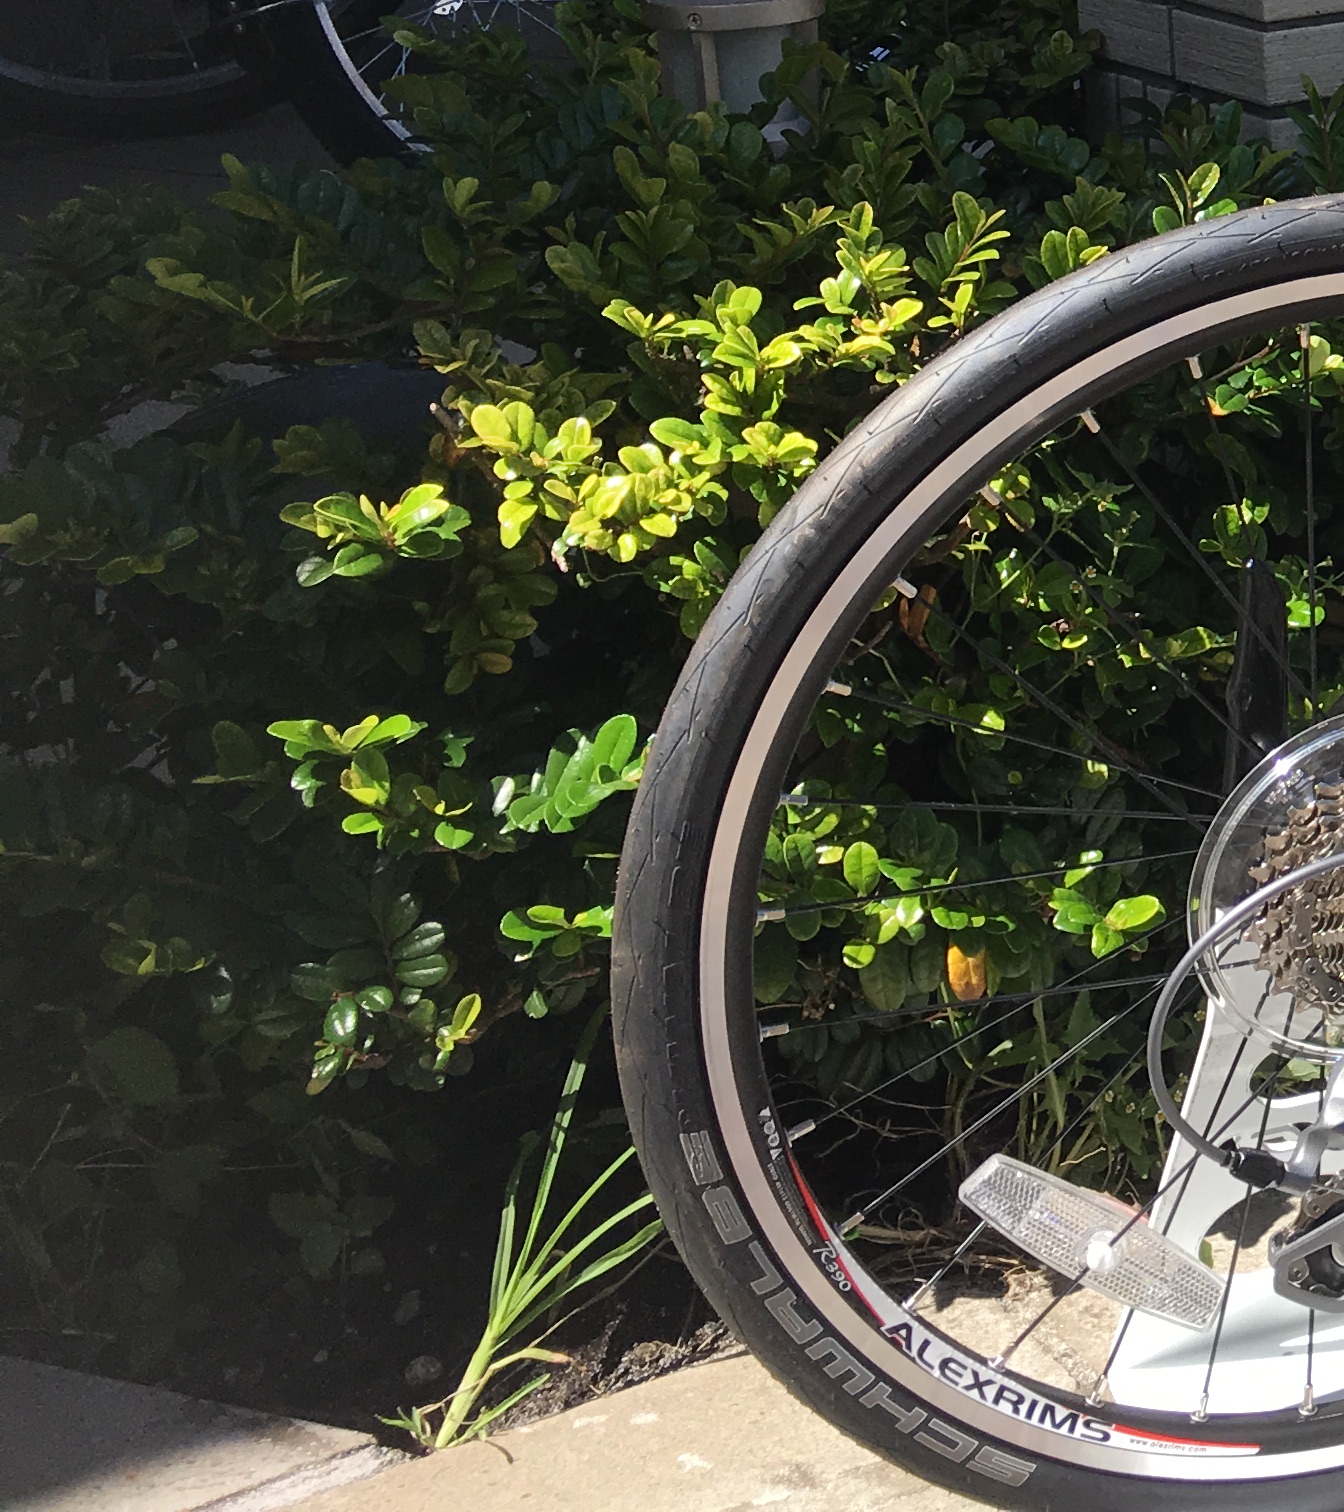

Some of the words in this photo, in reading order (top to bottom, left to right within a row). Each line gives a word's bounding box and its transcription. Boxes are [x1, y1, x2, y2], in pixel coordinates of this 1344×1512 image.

[679, 1130, 1038, 1487] SCHWALBE
[812, 1239, 853, 1293] R390
[883, 1321, 1112, 1443] ALEXRIMS
